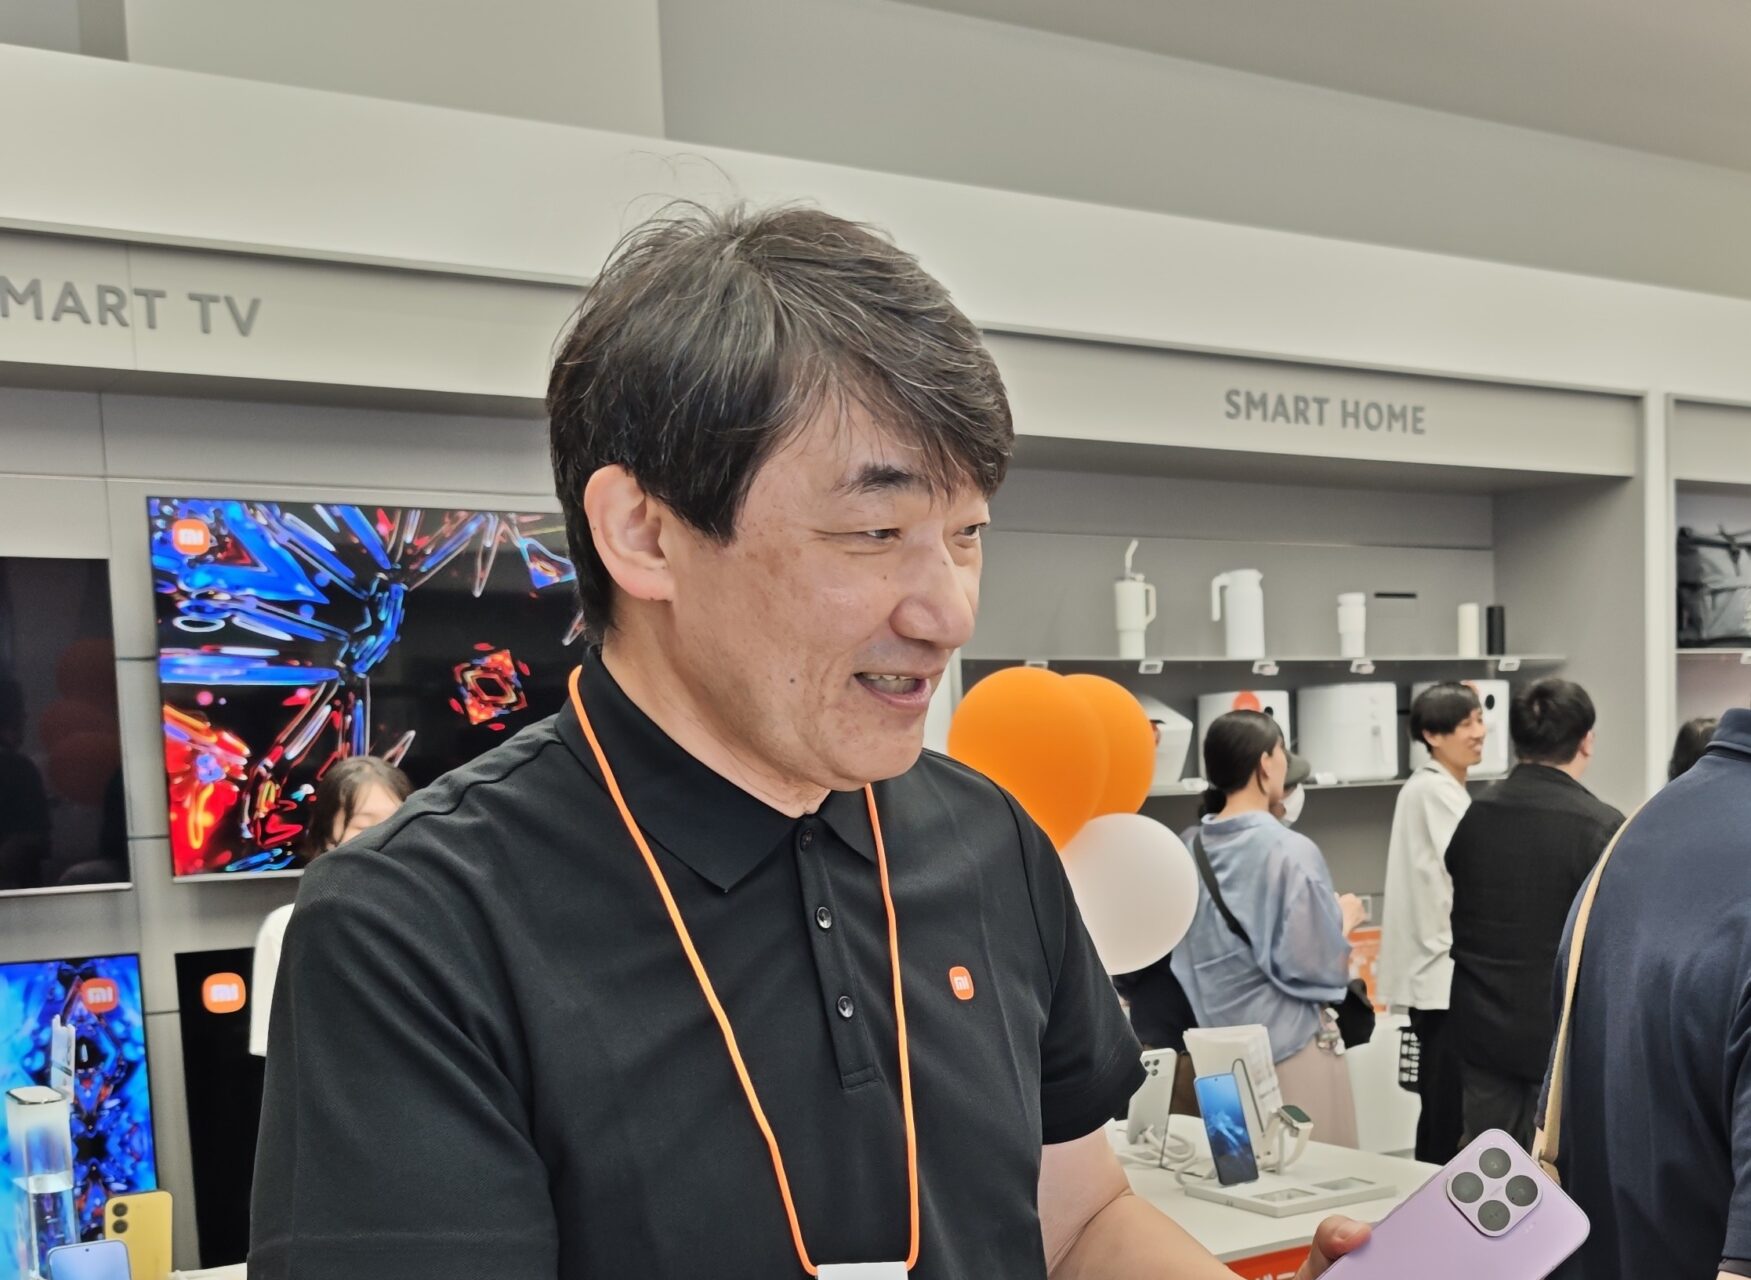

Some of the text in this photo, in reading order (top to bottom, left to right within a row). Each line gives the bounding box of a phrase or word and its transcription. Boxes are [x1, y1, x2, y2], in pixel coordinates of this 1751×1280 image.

[187, 292, 262, 337] TV
[1225, 388, 1427, 435] SMART HOME
